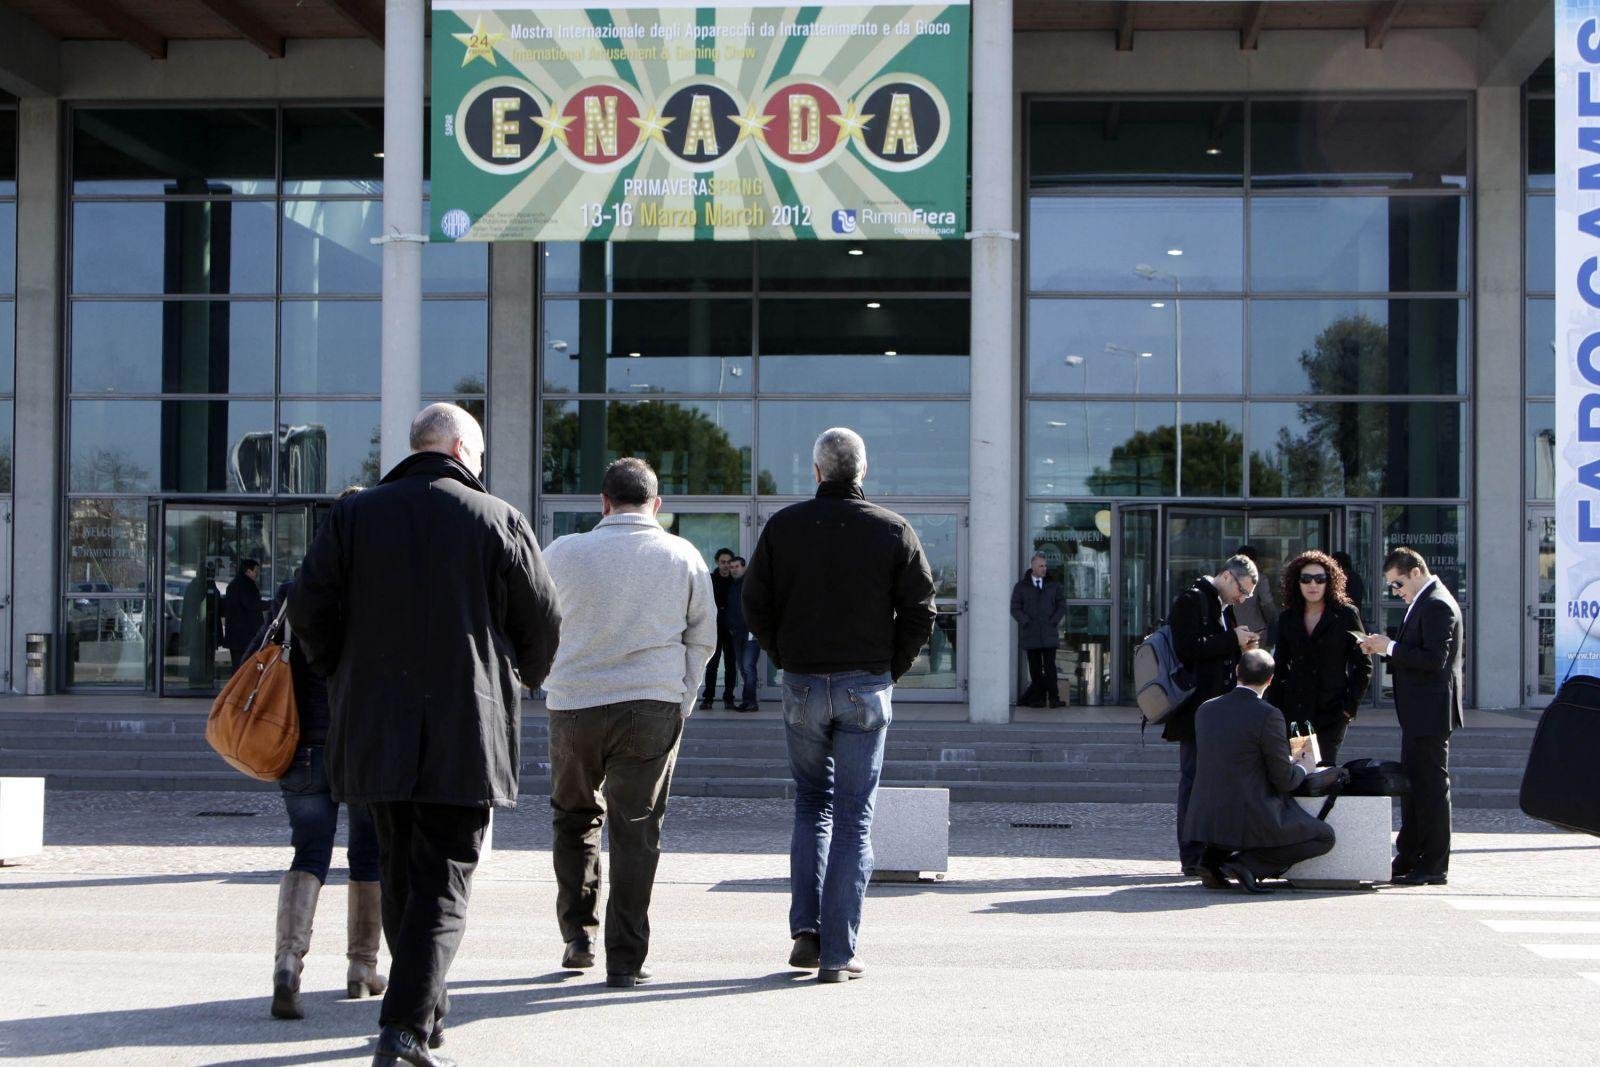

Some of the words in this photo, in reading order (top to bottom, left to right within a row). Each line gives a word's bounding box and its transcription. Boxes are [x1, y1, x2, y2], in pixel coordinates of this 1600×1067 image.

[511, 24, 552, 39] Mostra
[559, 23, 645, 39] Internazionale
[650, 23, 680, 41] degli
[686, 23, 755, 41] Apparecchi
[760, 22, 775, 37] da
[780, 21, 878, 37] Intrattenimento
[883, 24, 891, 36] e
[896, 21, 910, 36] da
[916, 20, 951, 36] Gioco
[470, 34, 488, 48] 24
[511, 46, 585, 61] International
[661, 47, 669, 60] &
[581, 202, 633, 228] 13-16
[640, 202, 697, 228] Marzo
[704, 200, 766, 228] March
[772, 205, 812, 227] 2012
[1567, 600, 1599, 618] FARO
[1567, 652, 1600, 661] www.far
